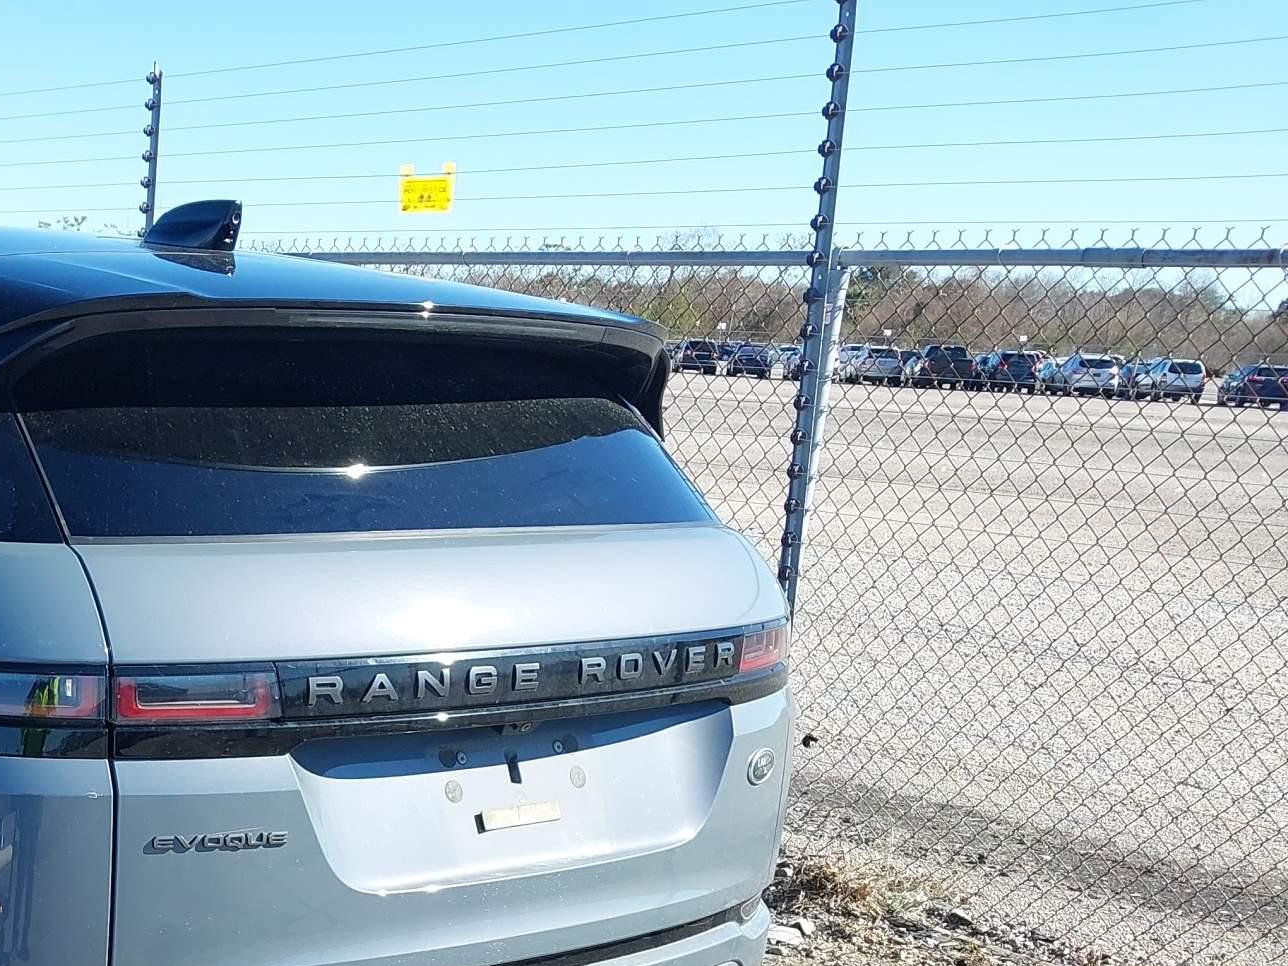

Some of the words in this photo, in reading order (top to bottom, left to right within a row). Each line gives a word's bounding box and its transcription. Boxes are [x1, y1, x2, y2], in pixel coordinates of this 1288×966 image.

[308, 662, 541, 704] RANGE
[579, 641, 735, 684] ROVER
[152, 830, 289, 849] EVOQUE
